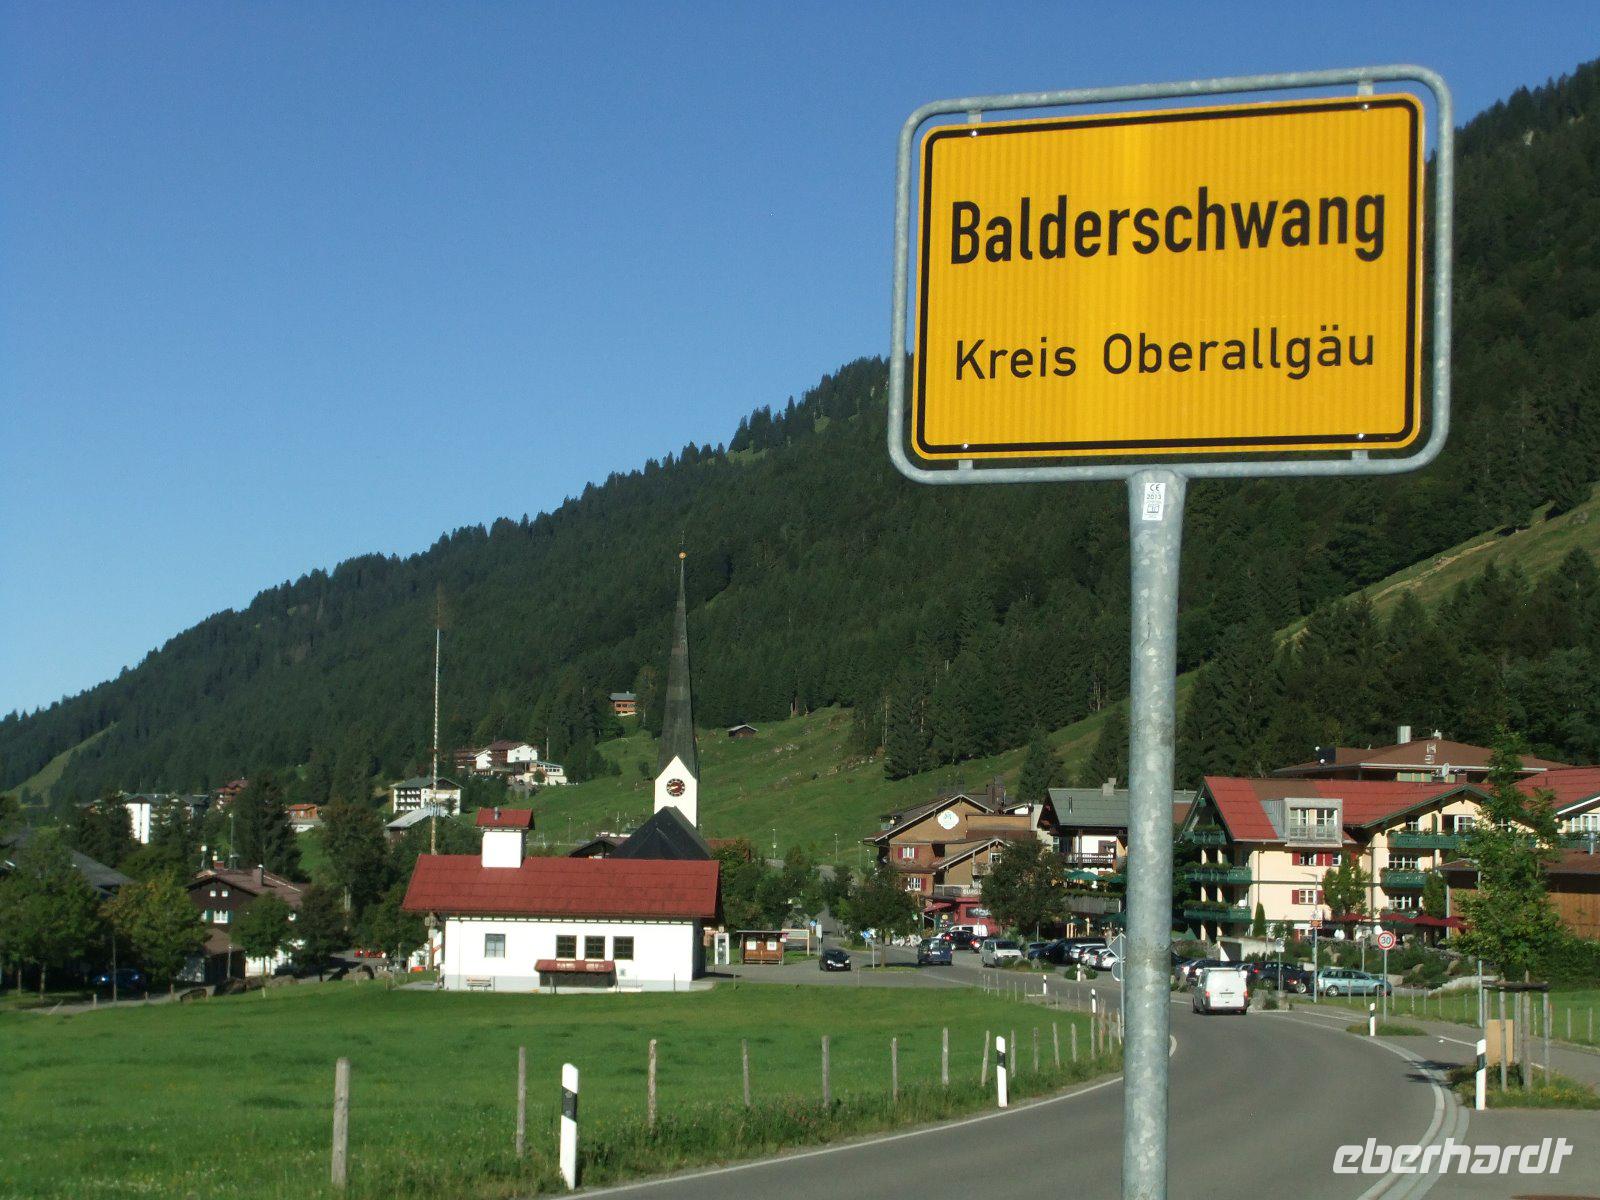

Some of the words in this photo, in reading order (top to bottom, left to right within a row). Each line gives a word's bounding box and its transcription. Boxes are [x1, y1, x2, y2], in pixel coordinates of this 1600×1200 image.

[952, 186, 1385, 264] Balderschwang
[957, 337, 1077, 380] Kreis
[1104, 325, 1374, 380] Oberallgäu
[1381, 936, 1391, 944] 30
